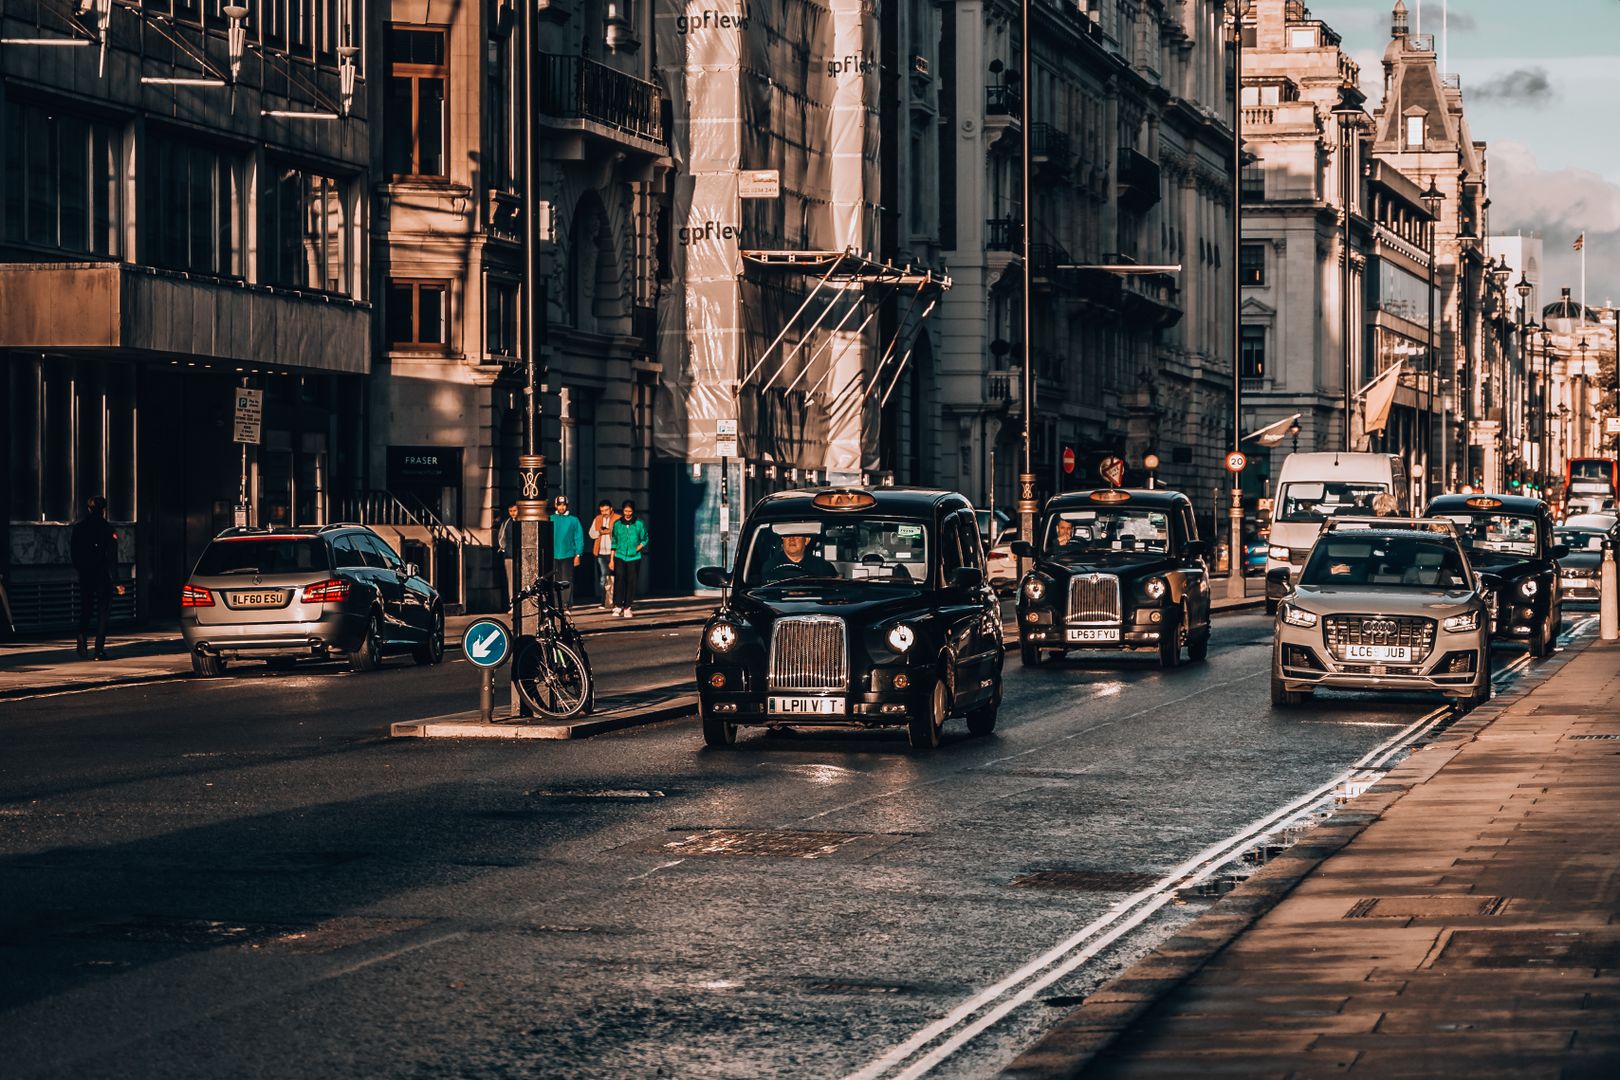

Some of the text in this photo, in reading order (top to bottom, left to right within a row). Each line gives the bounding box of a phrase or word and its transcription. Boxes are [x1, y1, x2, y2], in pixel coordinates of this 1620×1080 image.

[405, 456, 438, 465] FRASER
[1229, 458, 1243, 466] 20
[827, 495, 861, 505] TAXI
[237, 594, 283, 605] LF60 ESU
[1071, 630, 1116, 639] LP63 FYU
[1350, 646, 1405, 658] LC6 JUB
